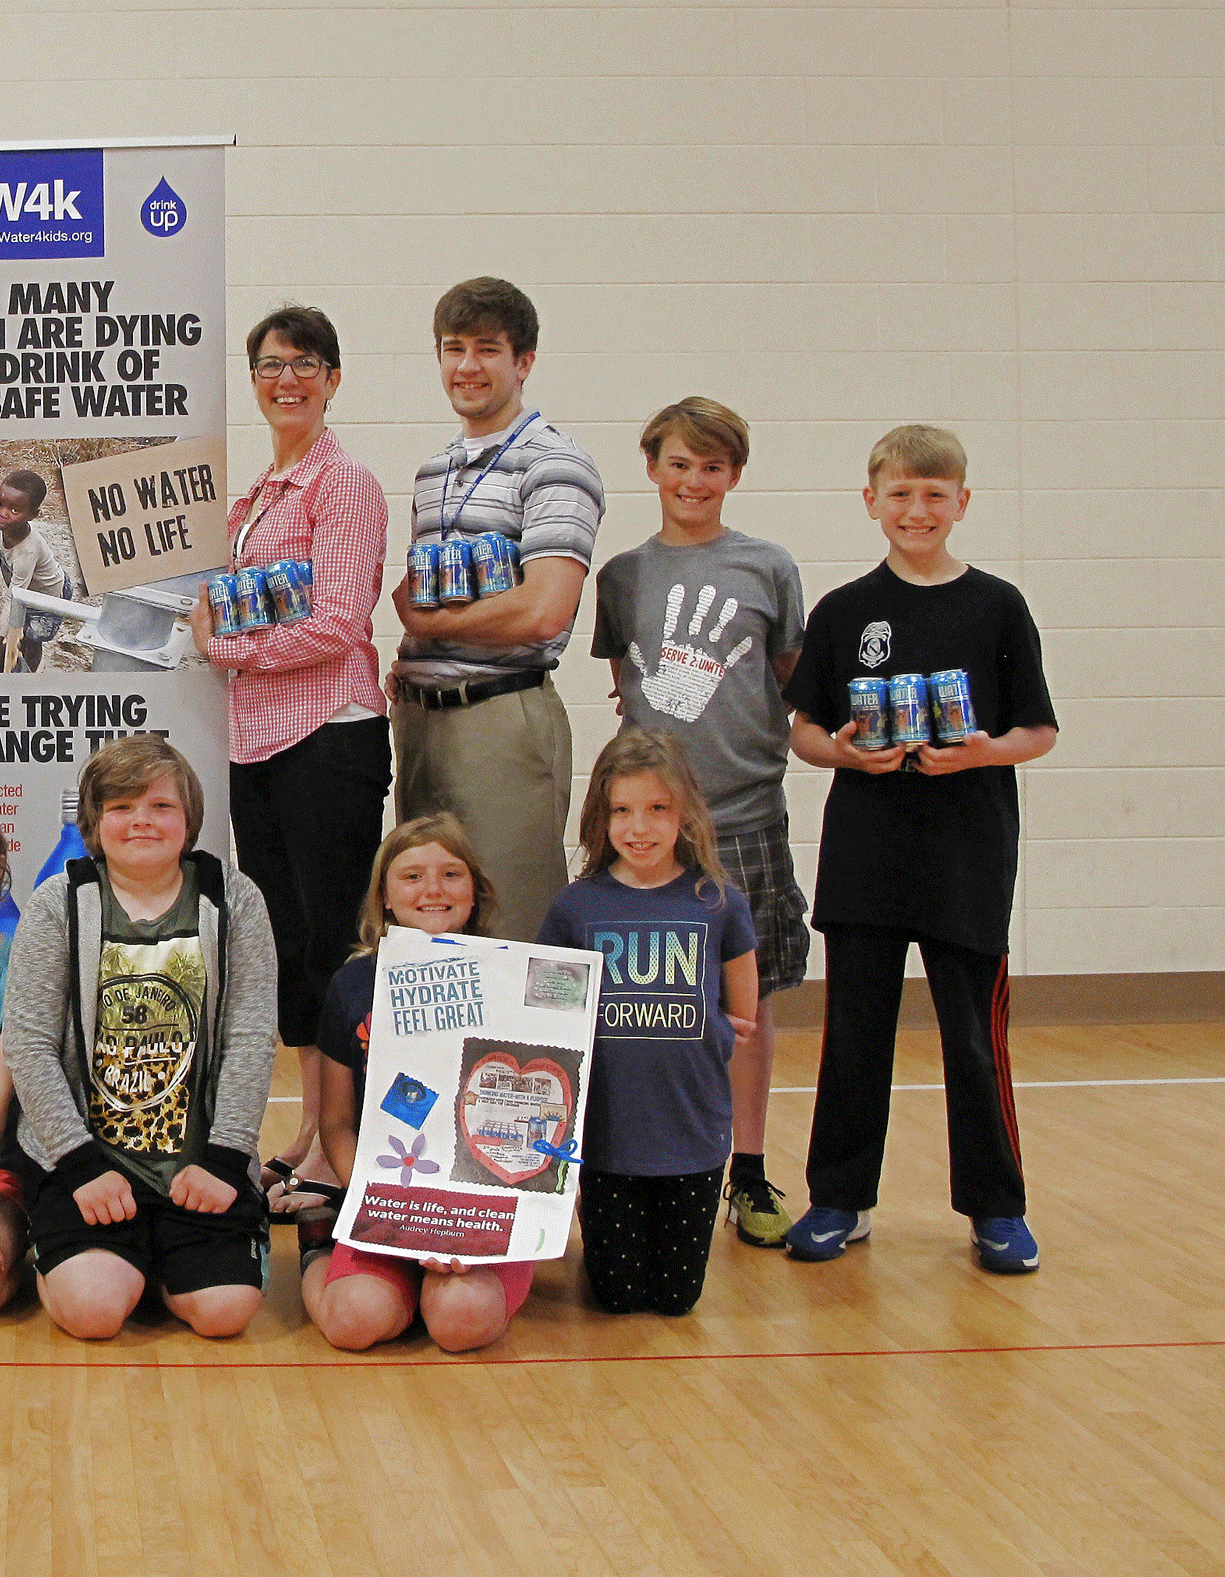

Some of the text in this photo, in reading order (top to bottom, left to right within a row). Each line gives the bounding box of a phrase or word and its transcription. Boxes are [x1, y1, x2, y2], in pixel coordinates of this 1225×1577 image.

[149, 200, 177, 210] drink
[150, 210, 178, 232] up
[8, 281, 114, 313] MANY
[17, 316, 83, 349] ARE
[95, 314, 202, 347] DYING
[116, 349, 160, 382] OF
[71, 384, 189, 417] WATER
[88, 464, 216, 524] NO WATER
[97, 514, 192, 567] NO LIFE
[660, 647, 689, 664] SERVE
[689, 655, 697, 668] 2
[22, 694, 148, 727] TRYING
[594, 931, 699, 986] RUN
[388, 961, 480, 986] MOTIVATE
[115, 986, 176, 1012] DE JANEIRO
[390, 979, 483, 1008] HYDRATE
[121, 1004, 148, 1025] 58
[393, 1001, 484, 1035] FEEL GREAT
[124, 1031, 183, 1058] PAULO
[104, 1064, 152, 1094] BRAZIL
[364, 1194, 516, 1220] Water is life, and clean
[367, 1209, 504, 1232] water means health.
[399, 1224, 465, 1238] Audrey Hepburn
